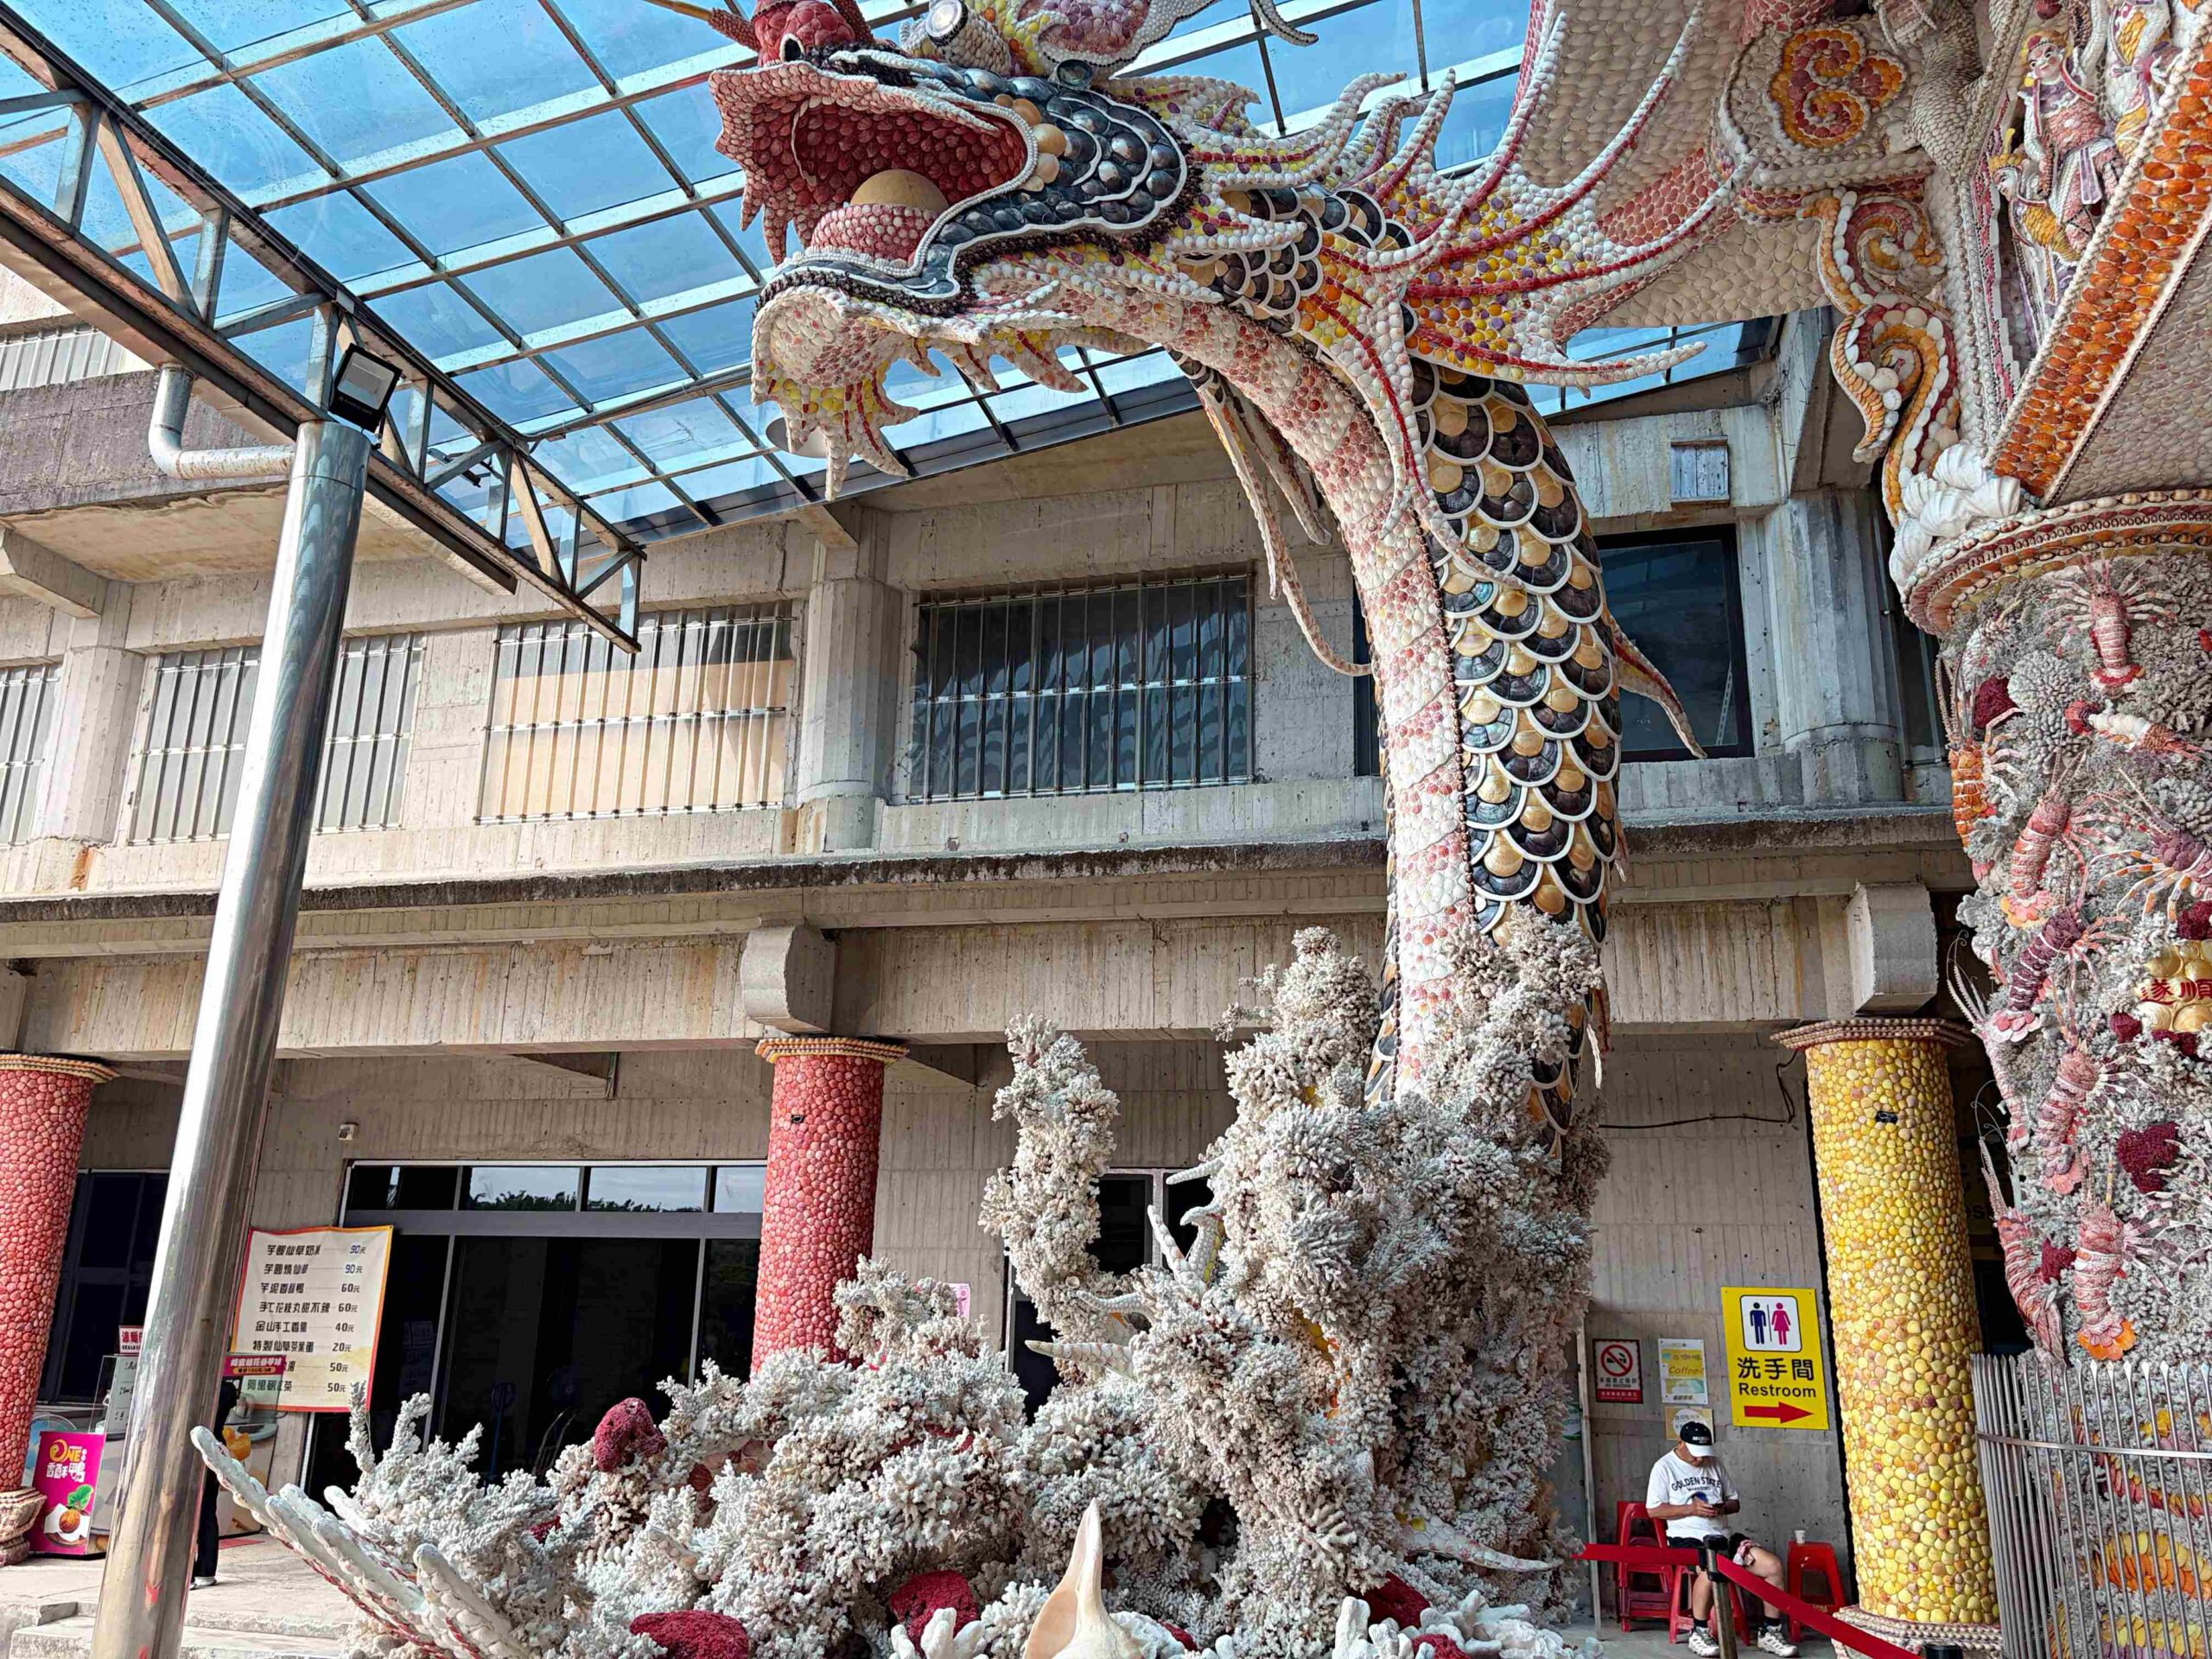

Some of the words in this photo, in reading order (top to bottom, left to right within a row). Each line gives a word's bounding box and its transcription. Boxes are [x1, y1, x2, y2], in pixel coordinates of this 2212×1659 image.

[349, 1244, 366, 1255] 90元
[345, 1264, 363, 1274] 90元
[341, 1283, 360, 1294] 60元
[338, 1303, 358, 1313] 60元
[335, 1322, 354, 1332] 40元
[332, 1342, 352, 1352] 20元
[330, 1362, 349, 1373] 50元
[1669, 1365, 1700, 1376] Coffee
[1737, 1357, 1815, 1382] 洗手間
[327, 1382, 346, 1392] 50元
[1738, 1382, 1816, 1398] Restroom
[1671, 1477, 1700, 1491] GOLDEN
[1700, 1477, 1721, 1489] STATE
